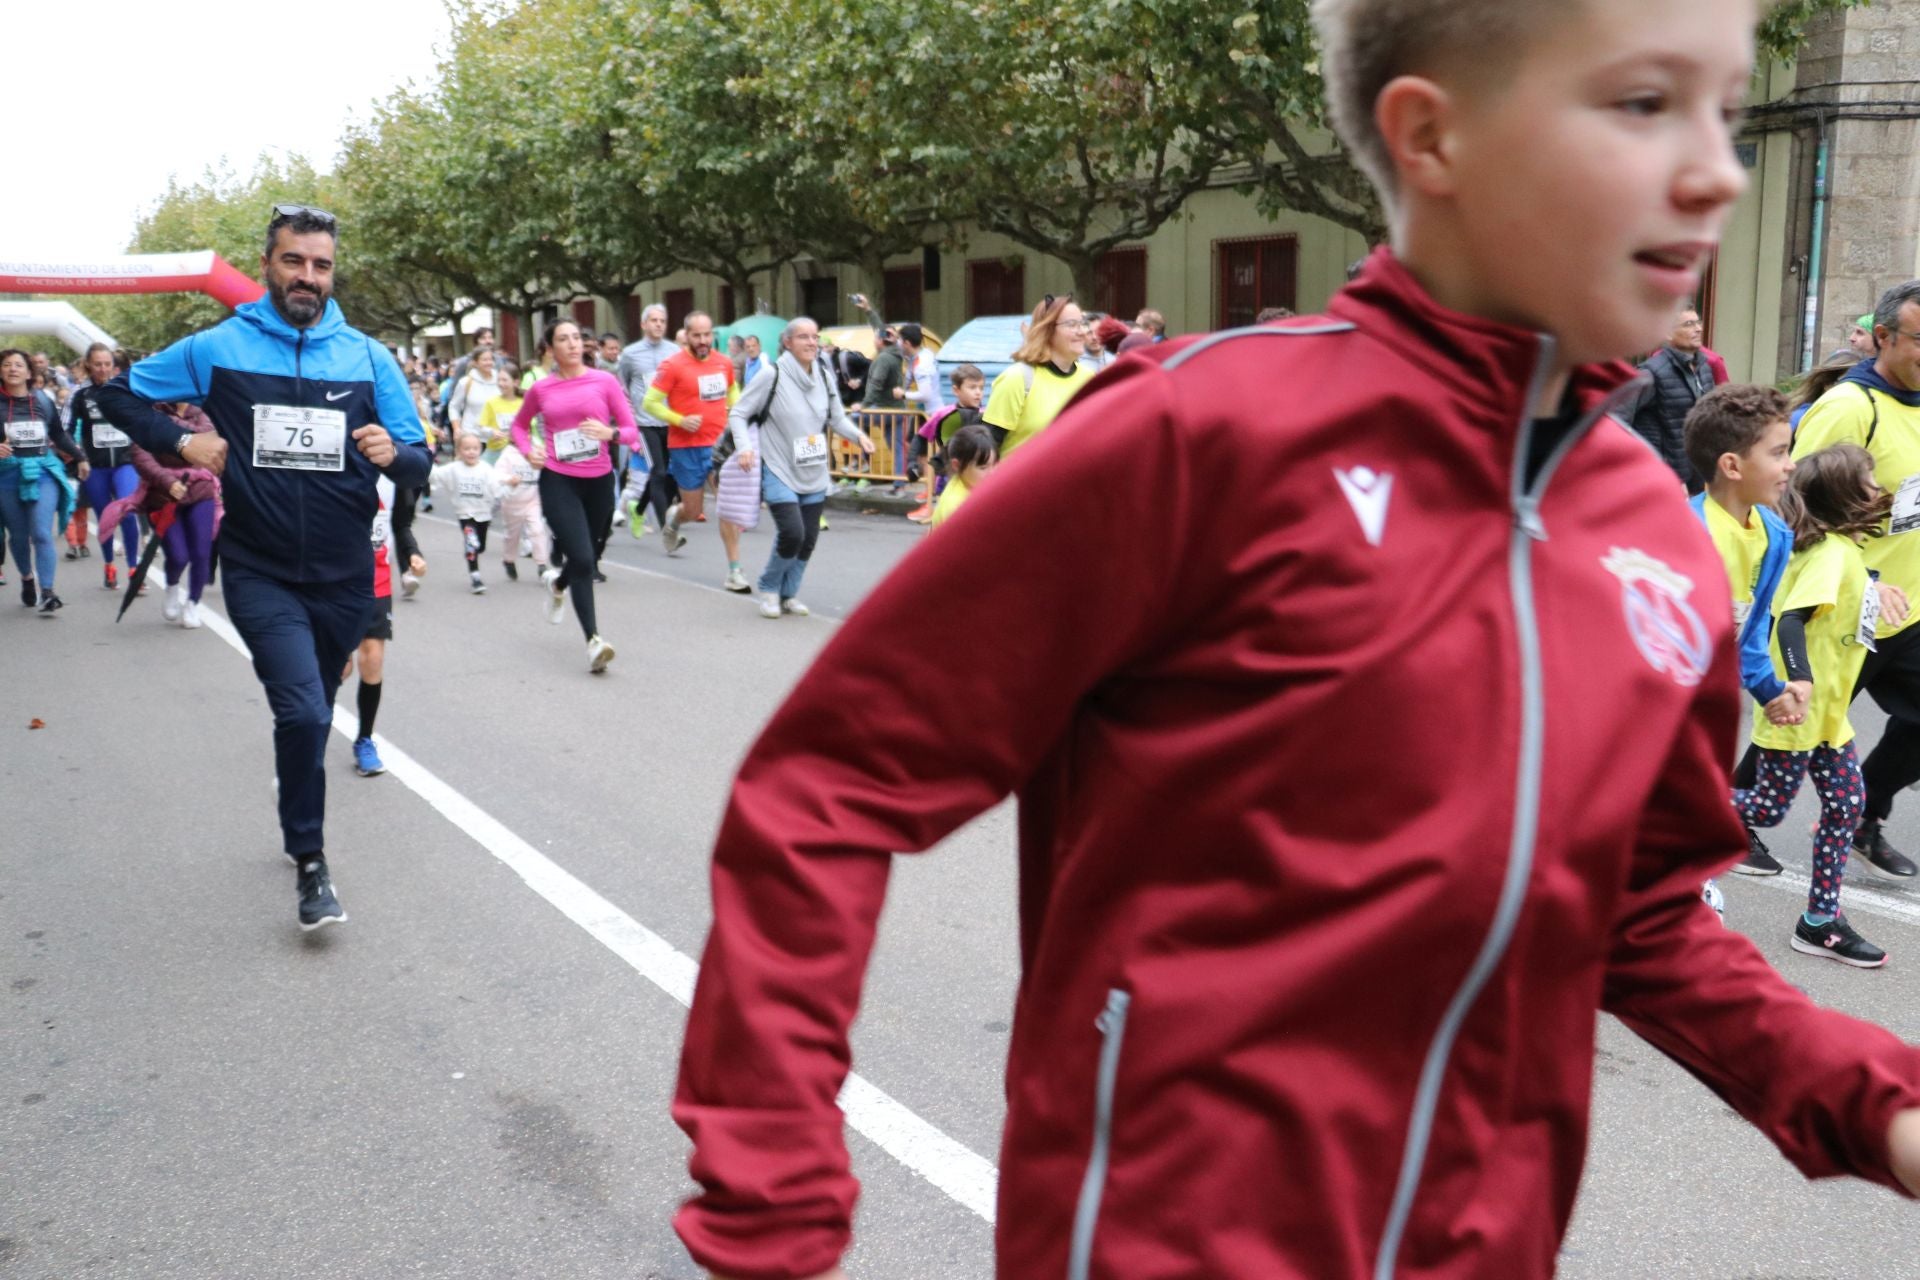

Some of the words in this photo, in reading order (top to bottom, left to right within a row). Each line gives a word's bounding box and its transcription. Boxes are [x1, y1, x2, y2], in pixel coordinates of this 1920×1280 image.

[103, 264, 118, 274] DE
[77, 279, 89, 287] DE
[91, 278, 137, 287] DEPORTES
[16, 430, 36, 440] 398
[284, 426, 315, 448] 76
[571, 438, 585, 451] 13
